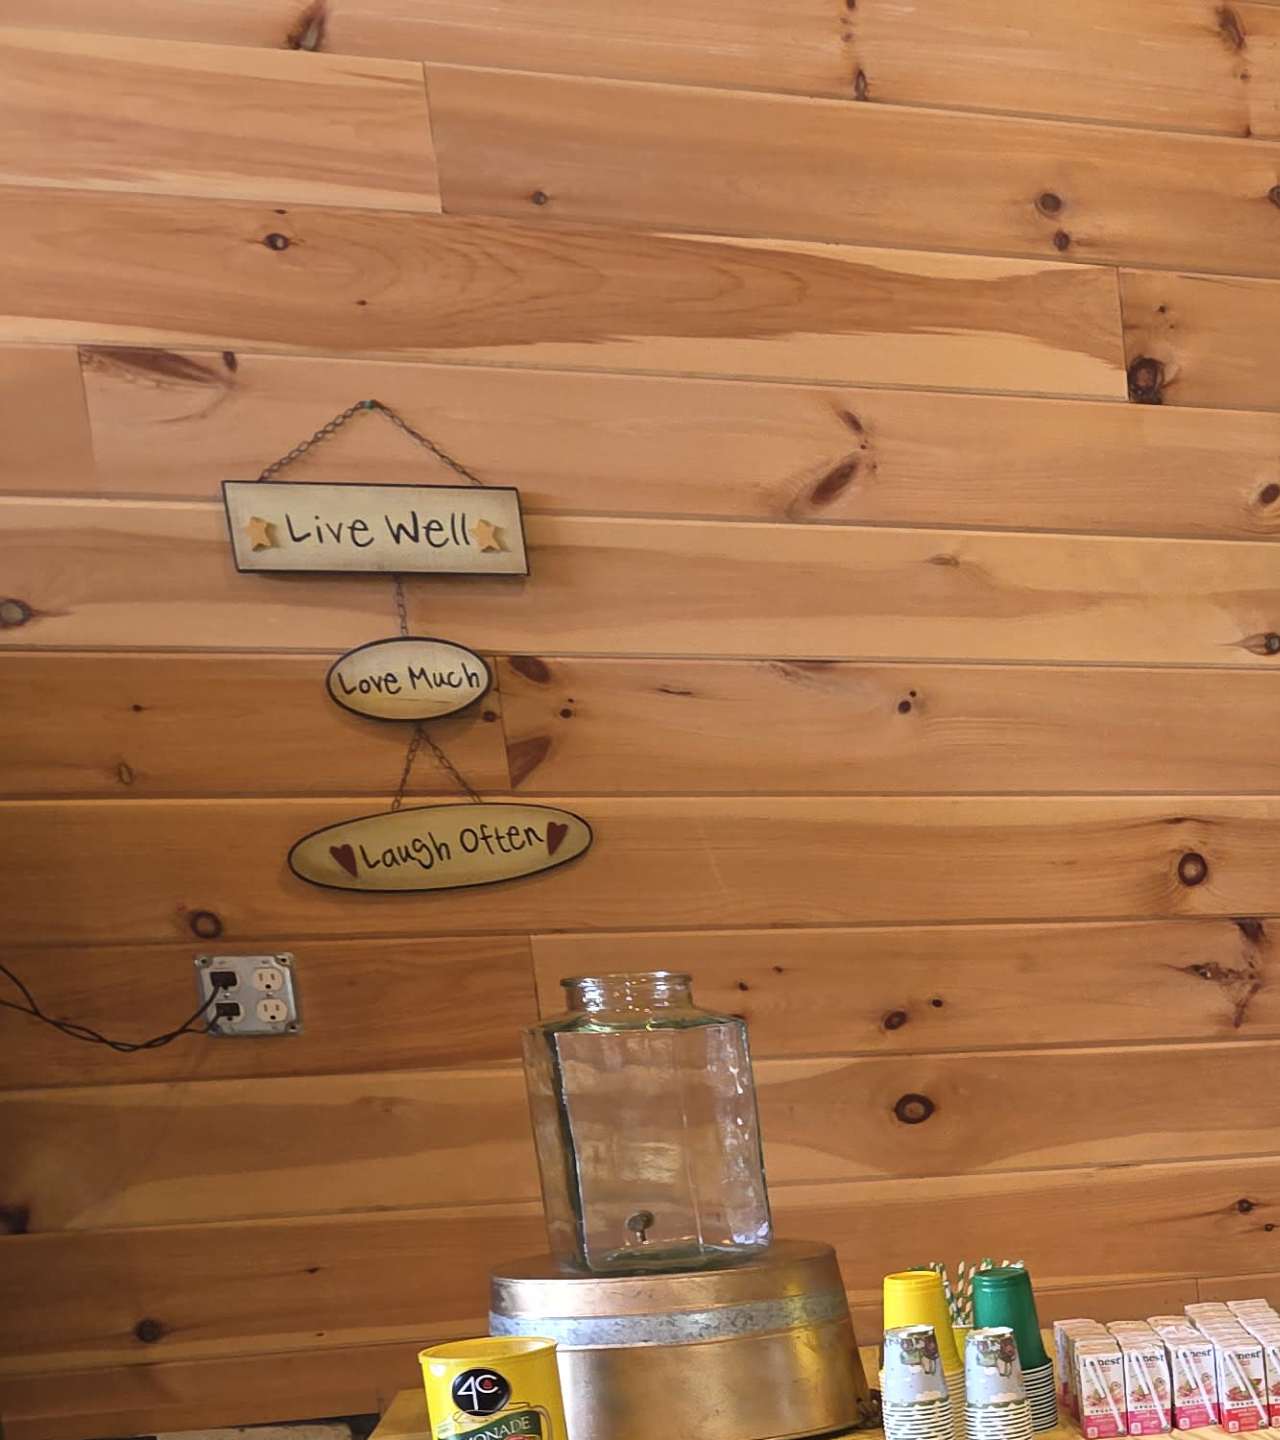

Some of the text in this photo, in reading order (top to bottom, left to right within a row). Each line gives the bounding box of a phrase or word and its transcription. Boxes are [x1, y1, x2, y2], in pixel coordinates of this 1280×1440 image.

[285, 511, 471, 548] Live Well
[337, 662, 480, 695] Love Much
[360, 824, 544, 869] Laugh Often
[457, 1374, 499, 1412] 4C
